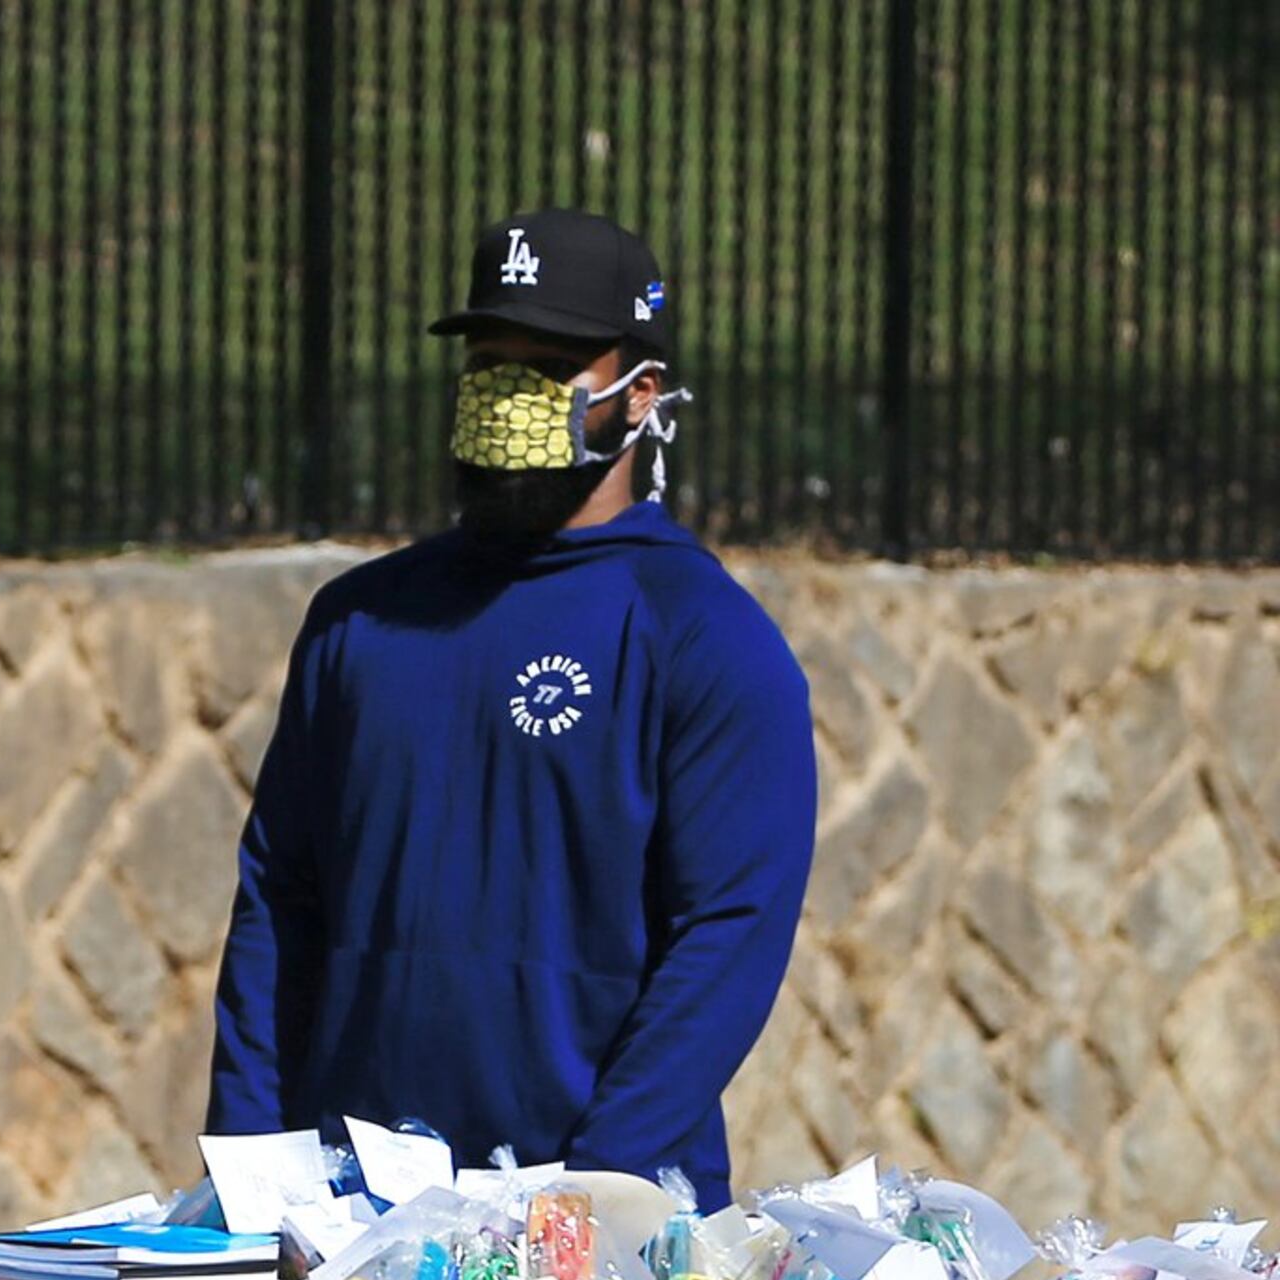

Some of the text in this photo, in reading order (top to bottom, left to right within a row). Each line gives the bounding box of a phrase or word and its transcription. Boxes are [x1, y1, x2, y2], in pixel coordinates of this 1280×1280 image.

[500, 228, 540, 285] LA
[516, 654, 592, 696] AMERICAN
[548, 705, 583, 736] USA
